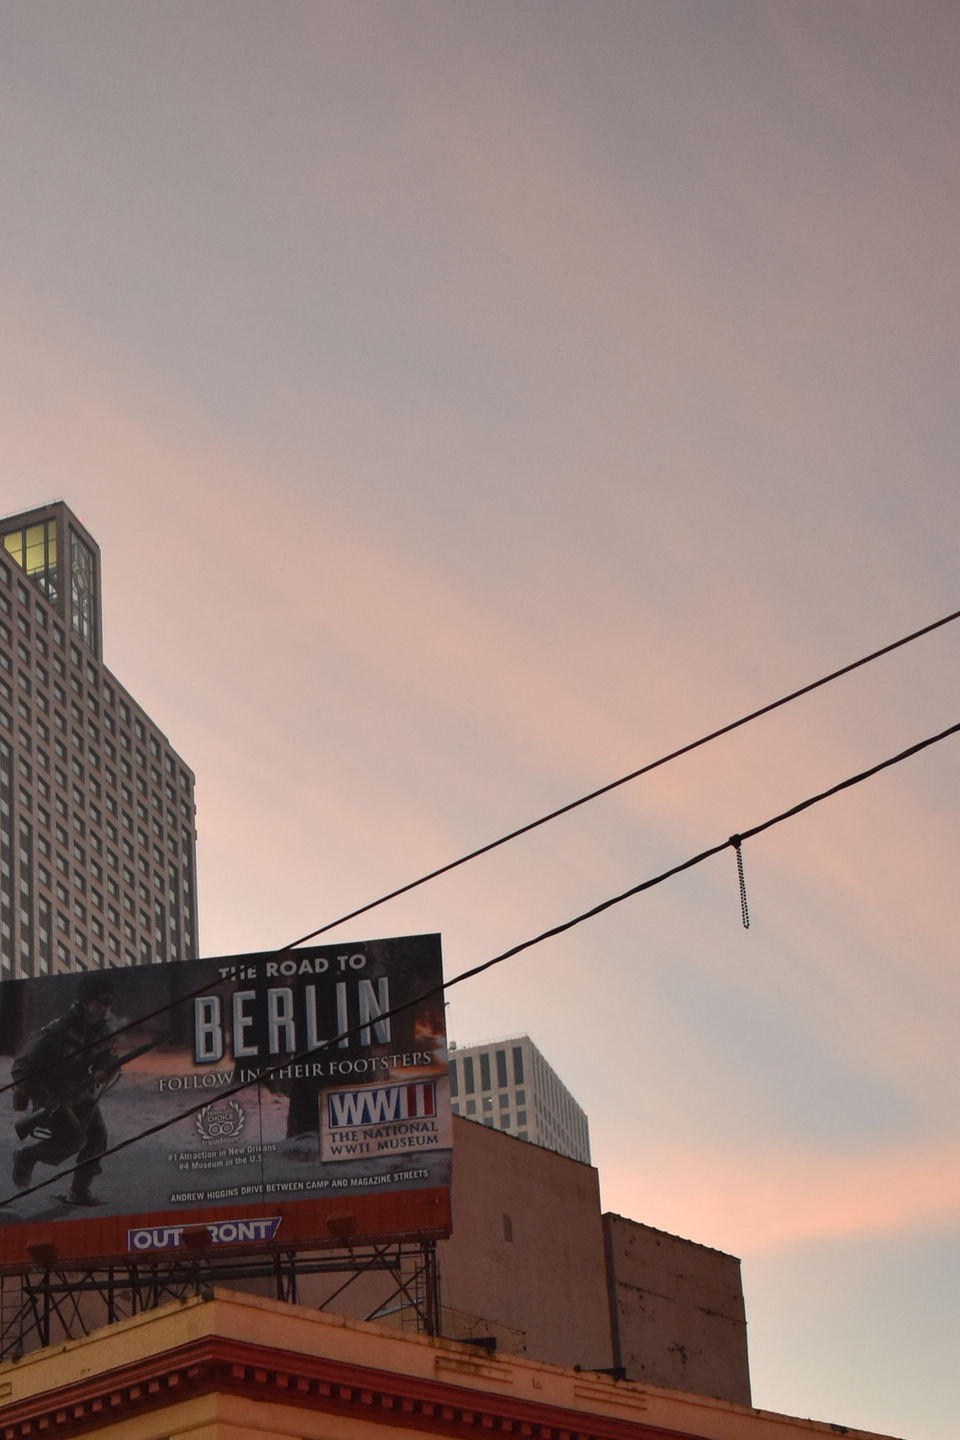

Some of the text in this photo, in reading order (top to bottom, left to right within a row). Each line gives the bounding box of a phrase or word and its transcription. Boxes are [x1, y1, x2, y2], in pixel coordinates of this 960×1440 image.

[219, 954, 366, 981] THE ROAD TO
[194, 976, 391, 1064] BERLIN
[160, 1051, 431, 1092] FOLLOW IN THEIR FOOTSTEPS
[329, 1083, 437, 1128] WWII
[330, 1121, 439, 1143] THE NATIONAL
[330, 1134, 439, 1155] WWII MUSEUM
[168, 1143, 277, 1161] #1 Attraction in New Orleans
[192, 1160, 223, 1169] Museum
[225, 1159, 233, 1167] in
[171, 1169, 429, 1203] ANDREW HIGGINS DRIVE BETWEEN CAMP AND MAGAZINE STREETS
[133, 1221, 272, 1249] OUTRONT
